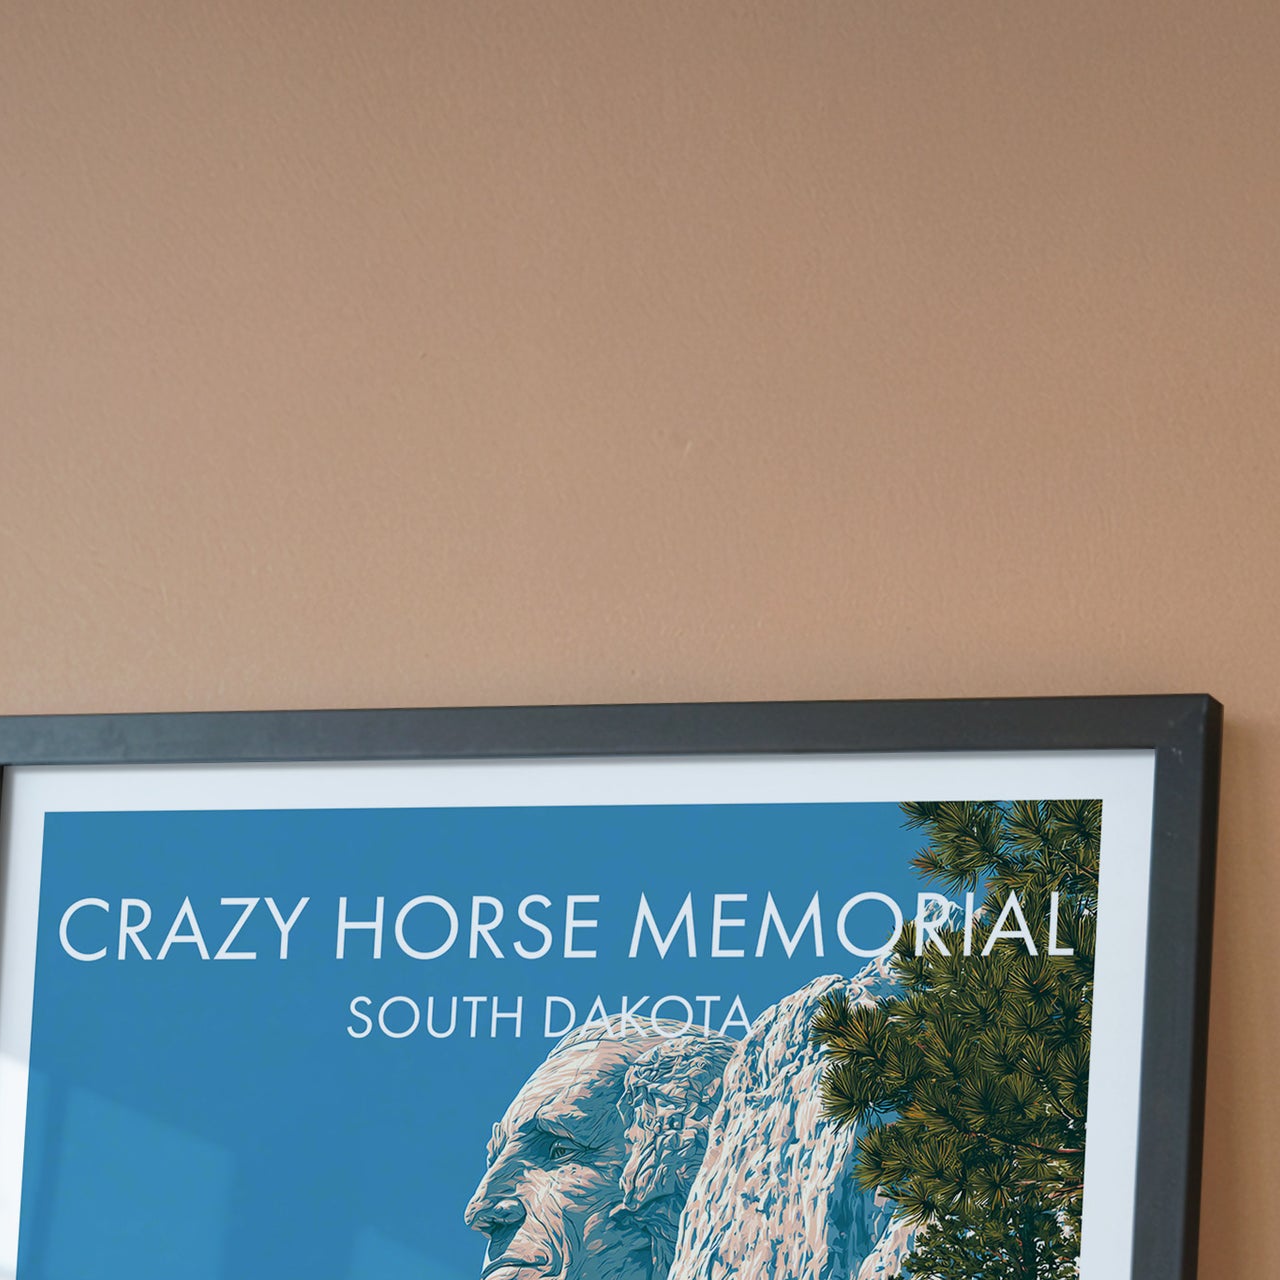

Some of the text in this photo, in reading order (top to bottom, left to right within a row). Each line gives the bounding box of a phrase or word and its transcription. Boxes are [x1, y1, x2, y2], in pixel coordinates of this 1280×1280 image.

[59, 890, 1075, 961] CRAZY HORSE MEMORIAL
[347, 994, 753, 1039] SOUTH DAKOTA
